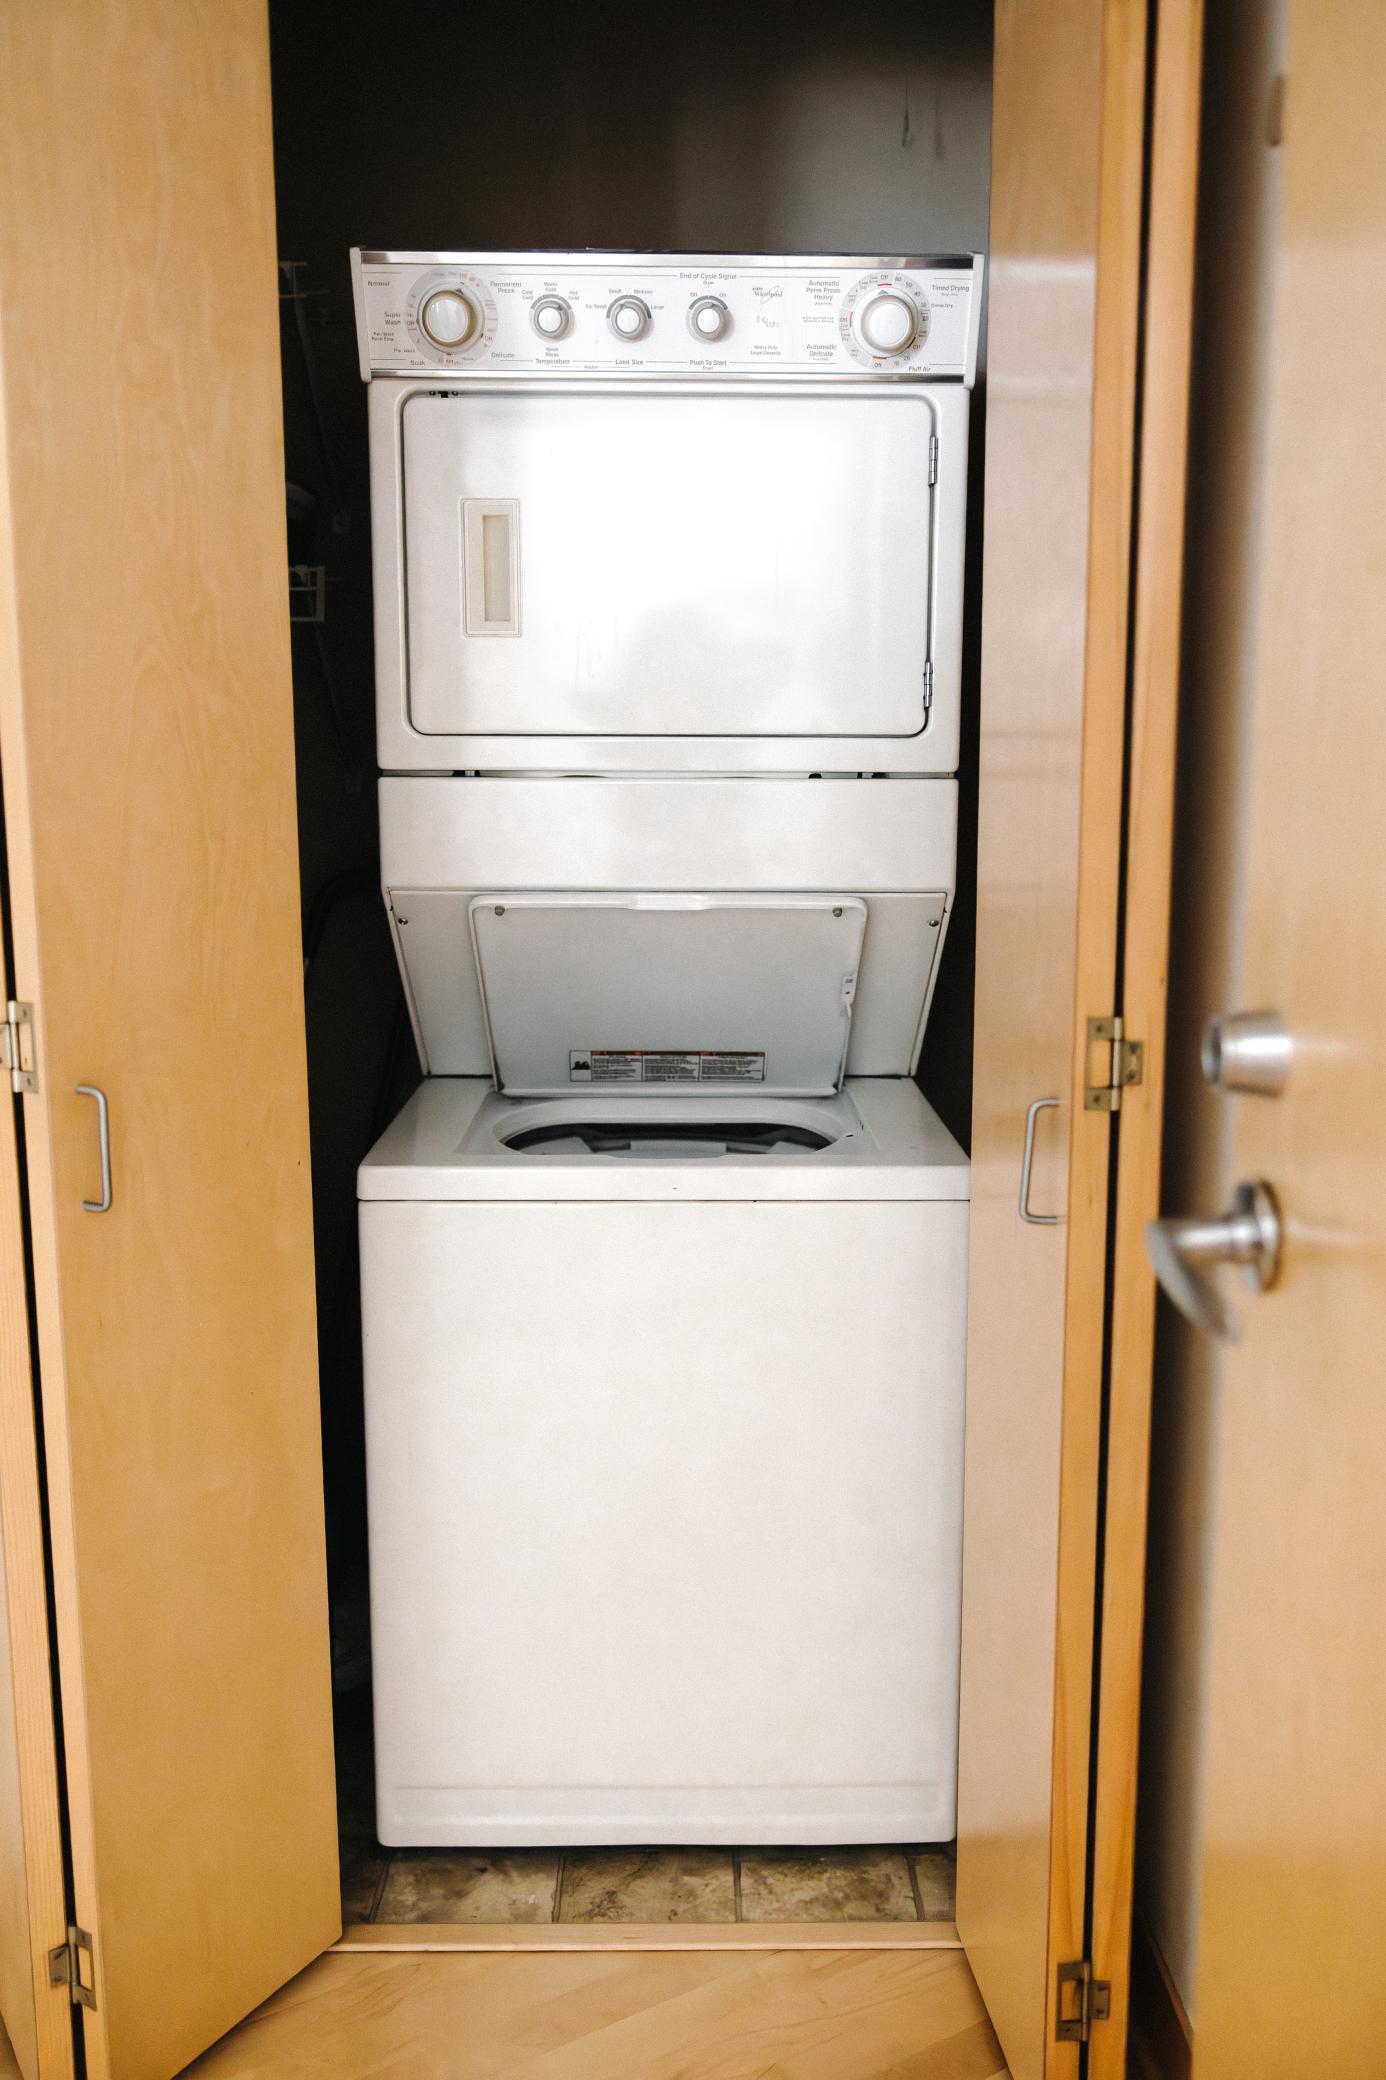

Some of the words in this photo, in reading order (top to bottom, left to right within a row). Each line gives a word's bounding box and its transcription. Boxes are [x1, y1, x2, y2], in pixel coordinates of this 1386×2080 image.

[700, 272, 717, 280] Cycle
[950, 285, 970, 293] Drying
[814, 294, 833, 302] Heavy
[806, 343, 838, 351] Automatic
[808, 350, 834, 358] Delicate
[535, 358, 571, 366] Temperature
[615, 358, 631, 366] Load
[632, 358, 644, 366] Size
[689, 359, 705, 367] Push
[705, 359, 713, 367] To
[712, 359, 727, 367] Start
